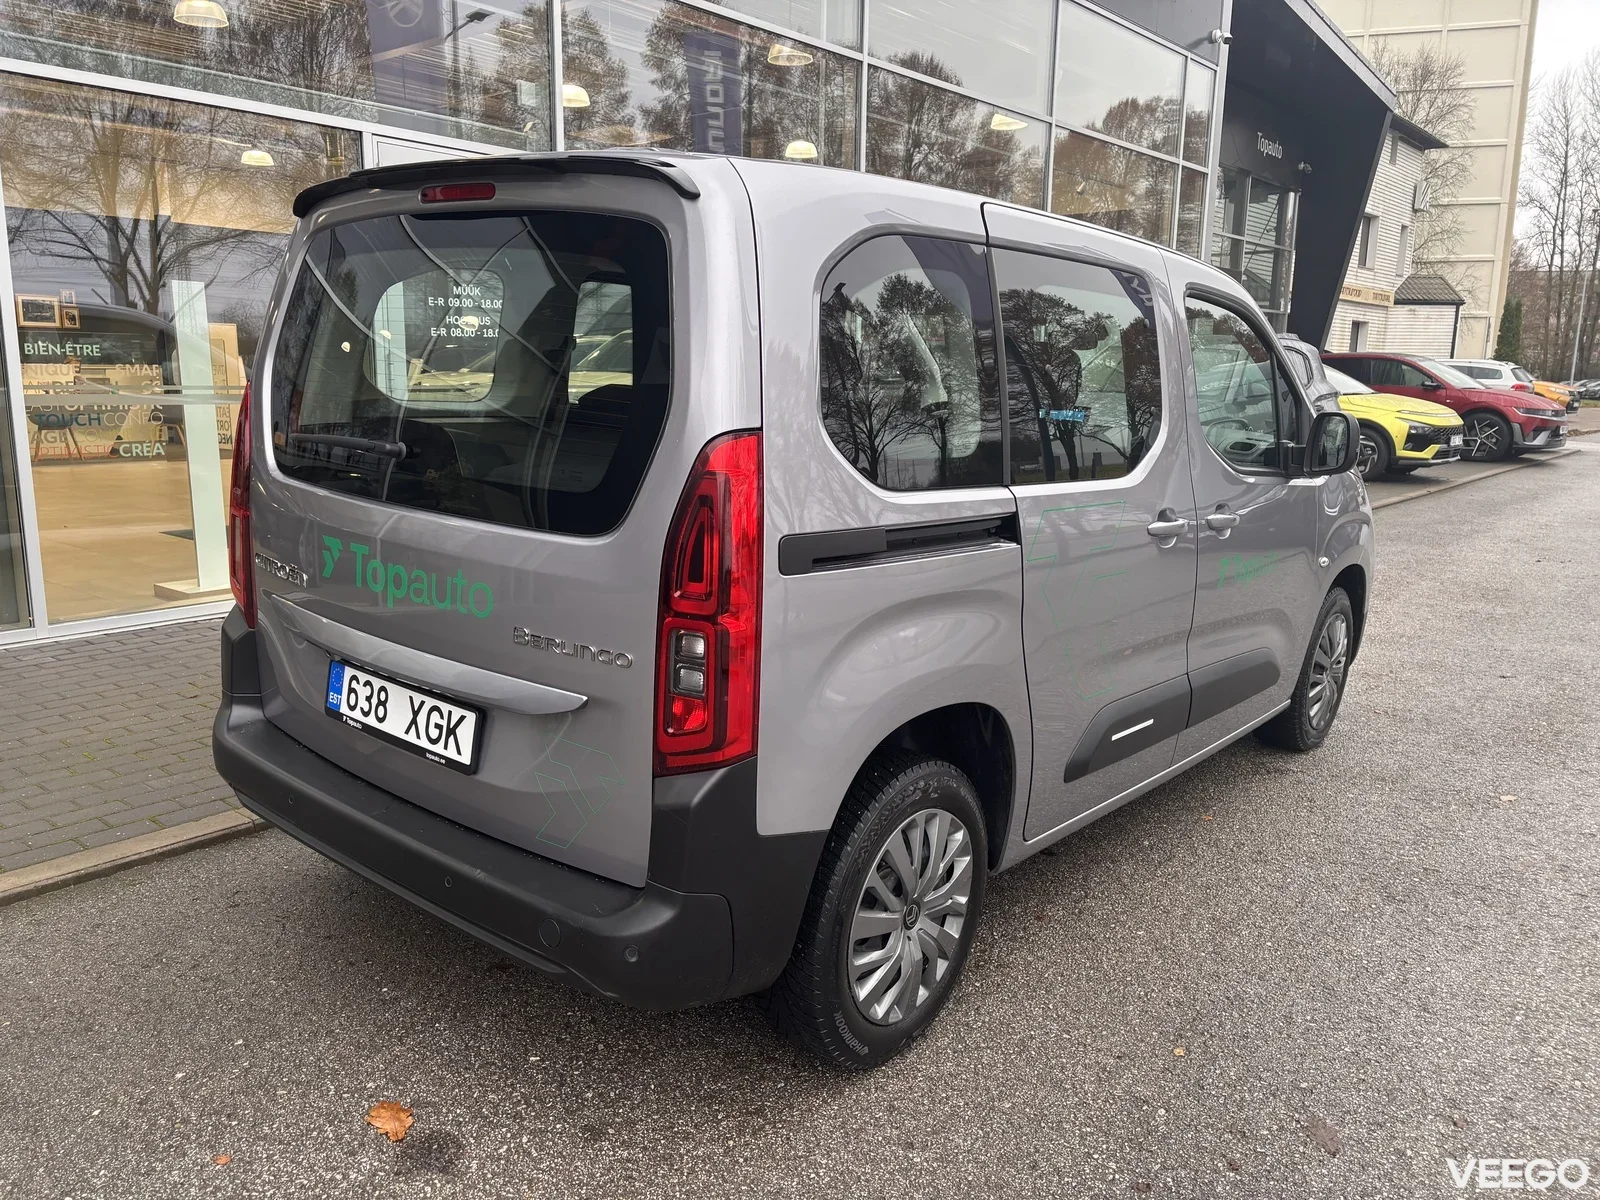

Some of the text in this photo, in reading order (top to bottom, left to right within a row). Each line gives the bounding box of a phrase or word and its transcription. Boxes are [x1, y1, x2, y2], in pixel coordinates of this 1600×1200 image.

[1257, 131, 1283, 159] Topauto
[453, 284, 481, 296] MÜÜK
[428, 297, 445, 306] E-R
[448, 297, 473, 308] 09.00
[446, 315, 491, 326] HOUS
[430, 327, 447, 337] E-R
[450, 328, 476, 337] 08.00
[24, 341, 102, 357] BIEN-ÊTRE
[34, 412, 101, 427] TOUCH
[119, 440, 166, 457] CRÉA
[255, 552, 309, 588] CITROËN
[350, 541, 494, 619] Topauto
[512, 625, 634, 669] BERLINGO
[329, 691, 342, 705] EST
[346, 674, 467, 756] 638 XGK
